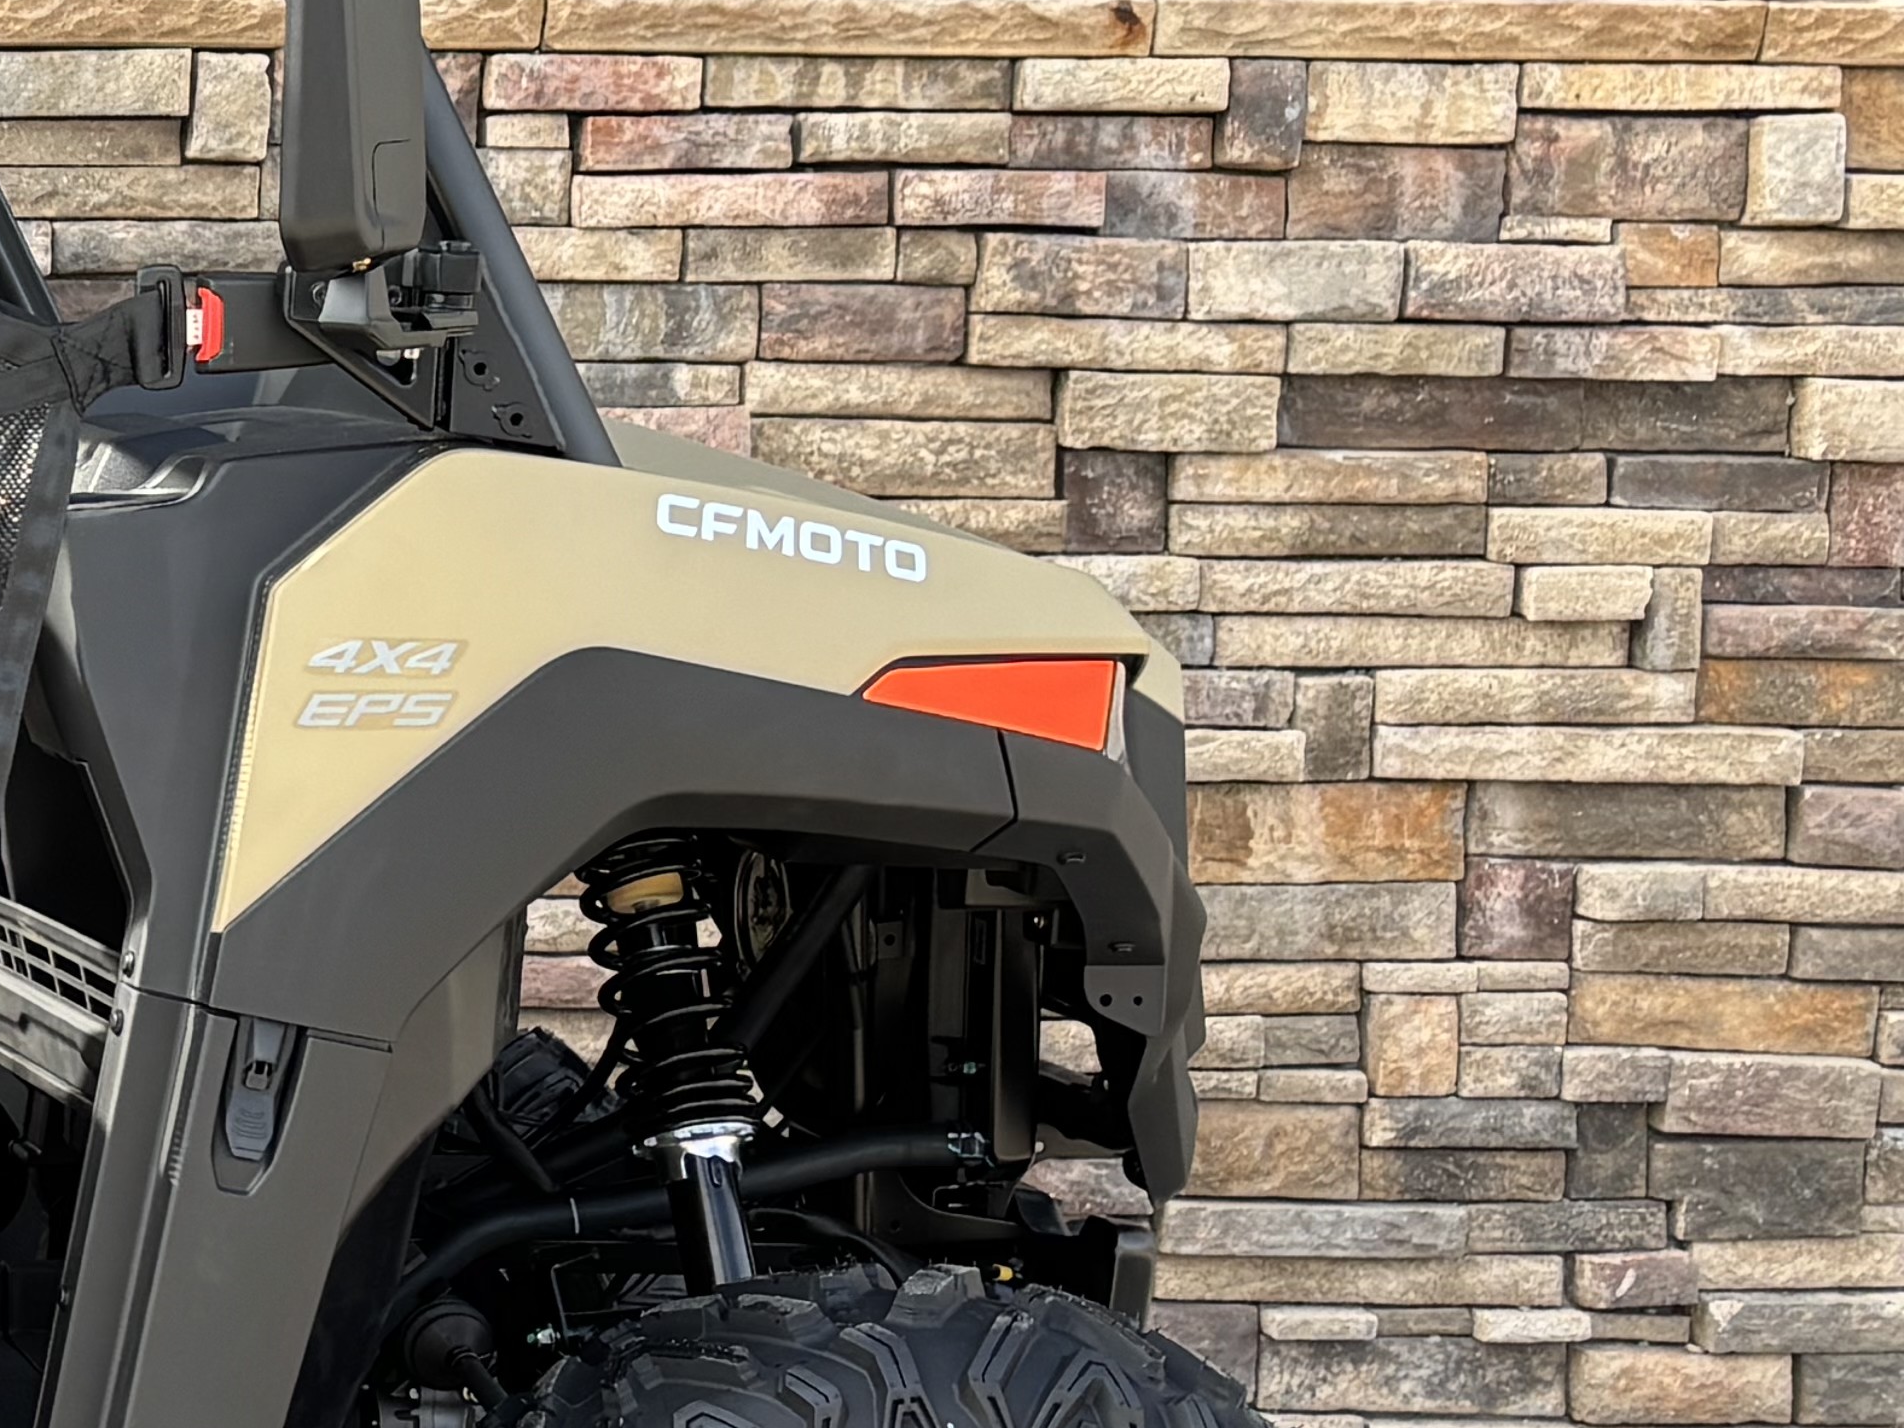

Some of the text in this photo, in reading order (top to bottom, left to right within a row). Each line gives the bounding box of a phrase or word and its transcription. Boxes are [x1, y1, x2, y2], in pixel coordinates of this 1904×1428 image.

[656, 493, 927, 582] CFMOTO
[307, 640, 459, 675] 4X4
[297, 693, 453, 727] EPS
